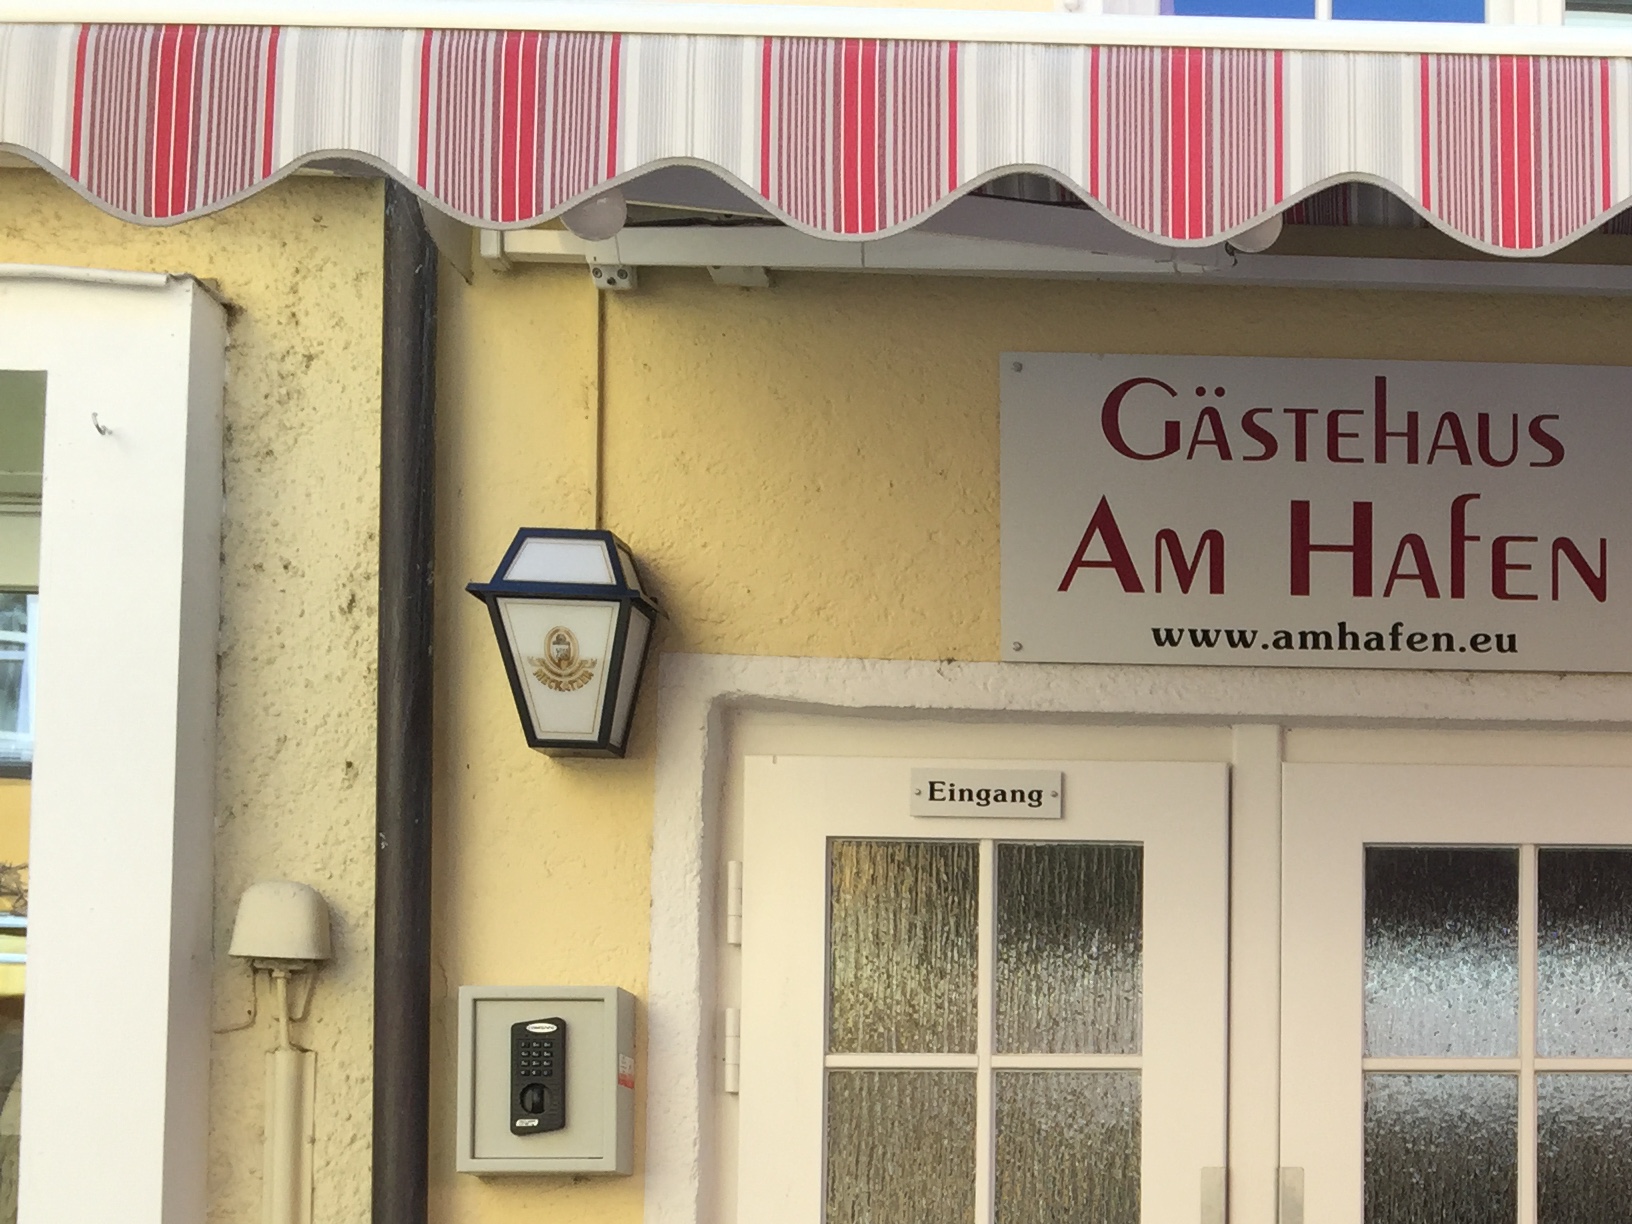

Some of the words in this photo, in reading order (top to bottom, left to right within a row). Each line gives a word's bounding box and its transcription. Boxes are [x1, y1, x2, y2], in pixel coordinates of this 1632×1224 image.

[1057, 493, 1225, 595] AM
[1151, 621, 1519, 654] www.amhafen.eu
[928, 780, 1044, 809] Eingang
